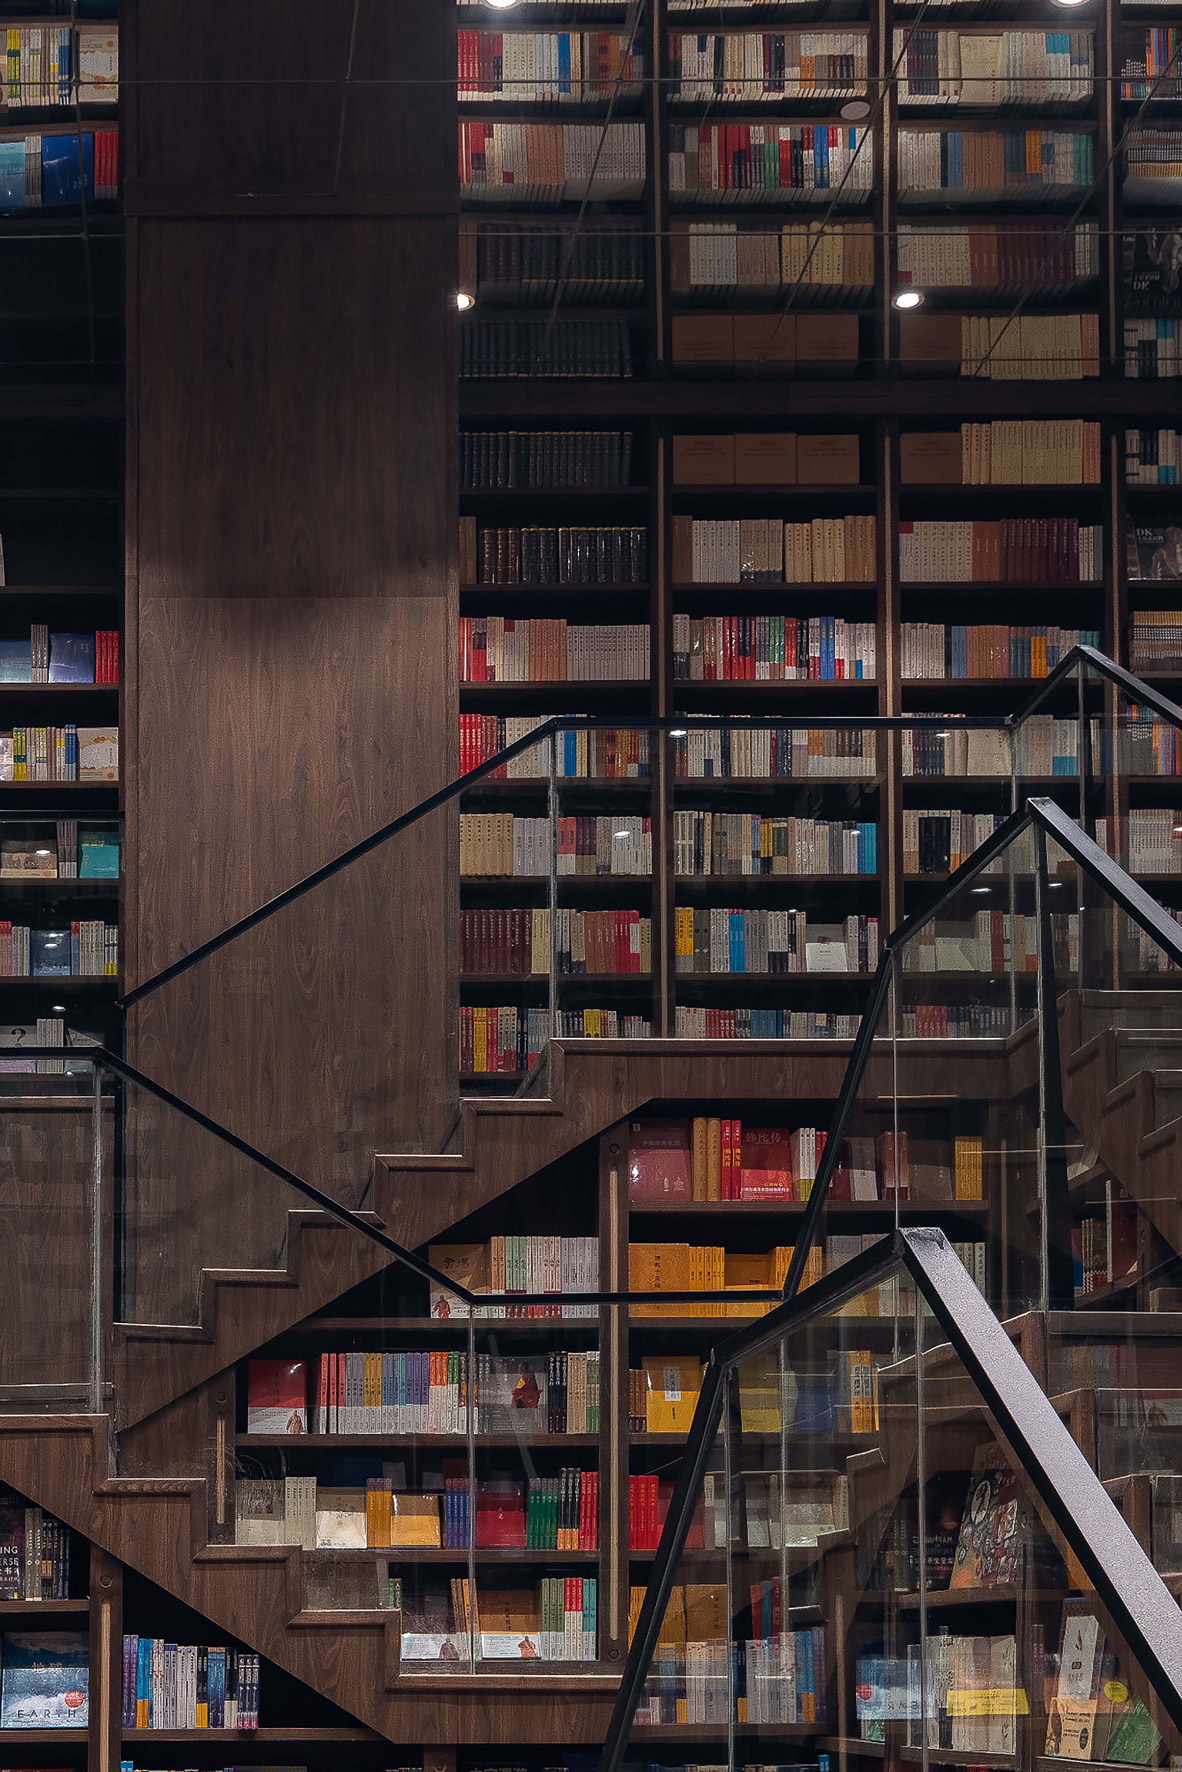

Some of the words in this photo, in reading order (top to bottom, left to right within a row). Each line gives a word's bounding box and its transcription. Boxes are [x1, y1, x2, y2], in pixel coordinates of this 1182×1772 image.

[745, 1132, 781, 1144] 佛陀传
[17, 1709, 76, 1718] EARTH
